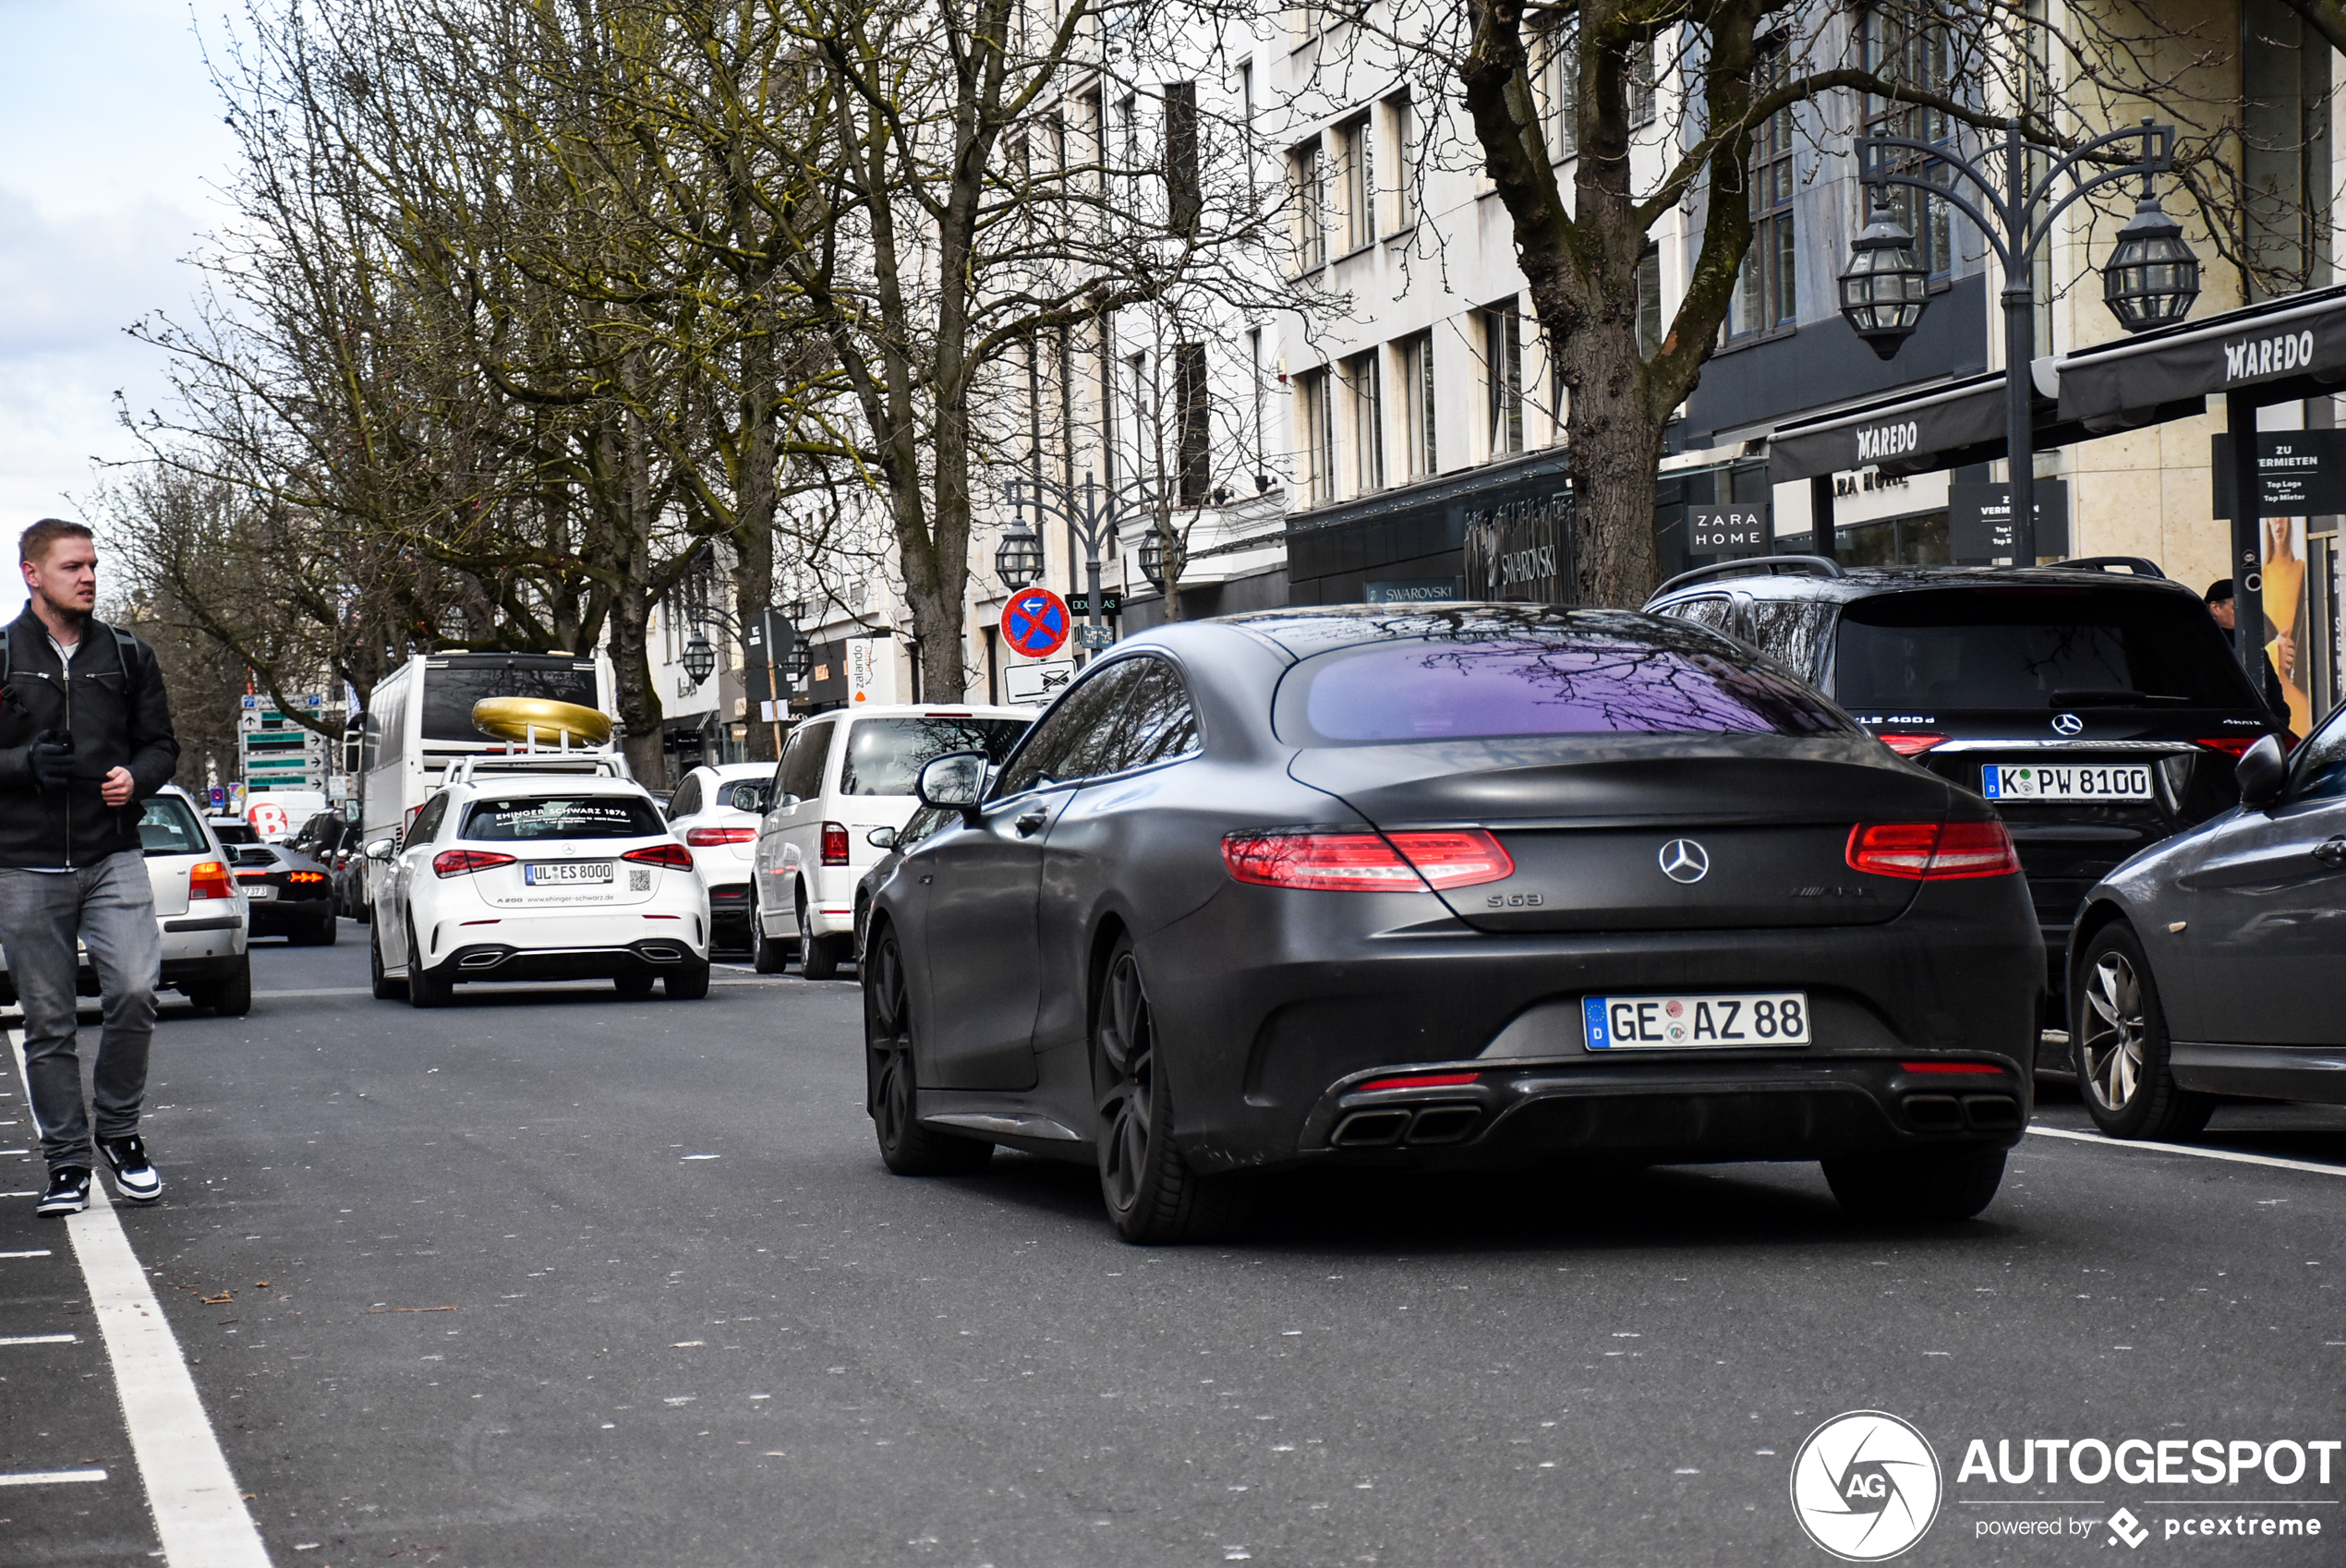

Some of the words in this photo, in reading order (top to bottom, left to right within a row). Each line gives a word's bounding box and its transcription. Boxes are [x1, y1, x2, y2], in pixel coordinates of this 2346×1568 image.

[2224, 330, 2314, 381] MAREDO
[1856, 420, 1917, 461] MAREDO
[2276, 446, 2292, 455] ZU
[2257, 456, 2317, 467] ERMIETEN
[2267, 481, 2281, 490] Top
[2002, 496, 2010, 504] Z
[2279, 493, 2305, 501] Mieter
[1698, 513, 1759, 527] ZARA
[1696, 531, 1761, 546] HOME
[1502, 544, 1557, 585] SWAROVSKI
[1386, 585, 1452, 601] SWAROVSKI
[853, 645, 865, 689] zalando
[2002, 773, 2019, 794] K
[2039, 772, 2072, 795] PW
[2080, 770, 2146, 794] 8100
[496, 809, 545, 820] EHINGER
[604, 808, 627, 817] 1876
[535, 867, 551, 880] UL
[561, 865, 577, 879] ES
[580, 864, 611, 878] 8000
[527, 895, 614, 903] www.ehinger-schwarz.de
[1593, 1028, 1602, 1040] D
[1611, 1002, 1663, 1042] GE
[1693, 1000, 1746, 1040] AZ
[1754, 999, 1804, 1039] 88
